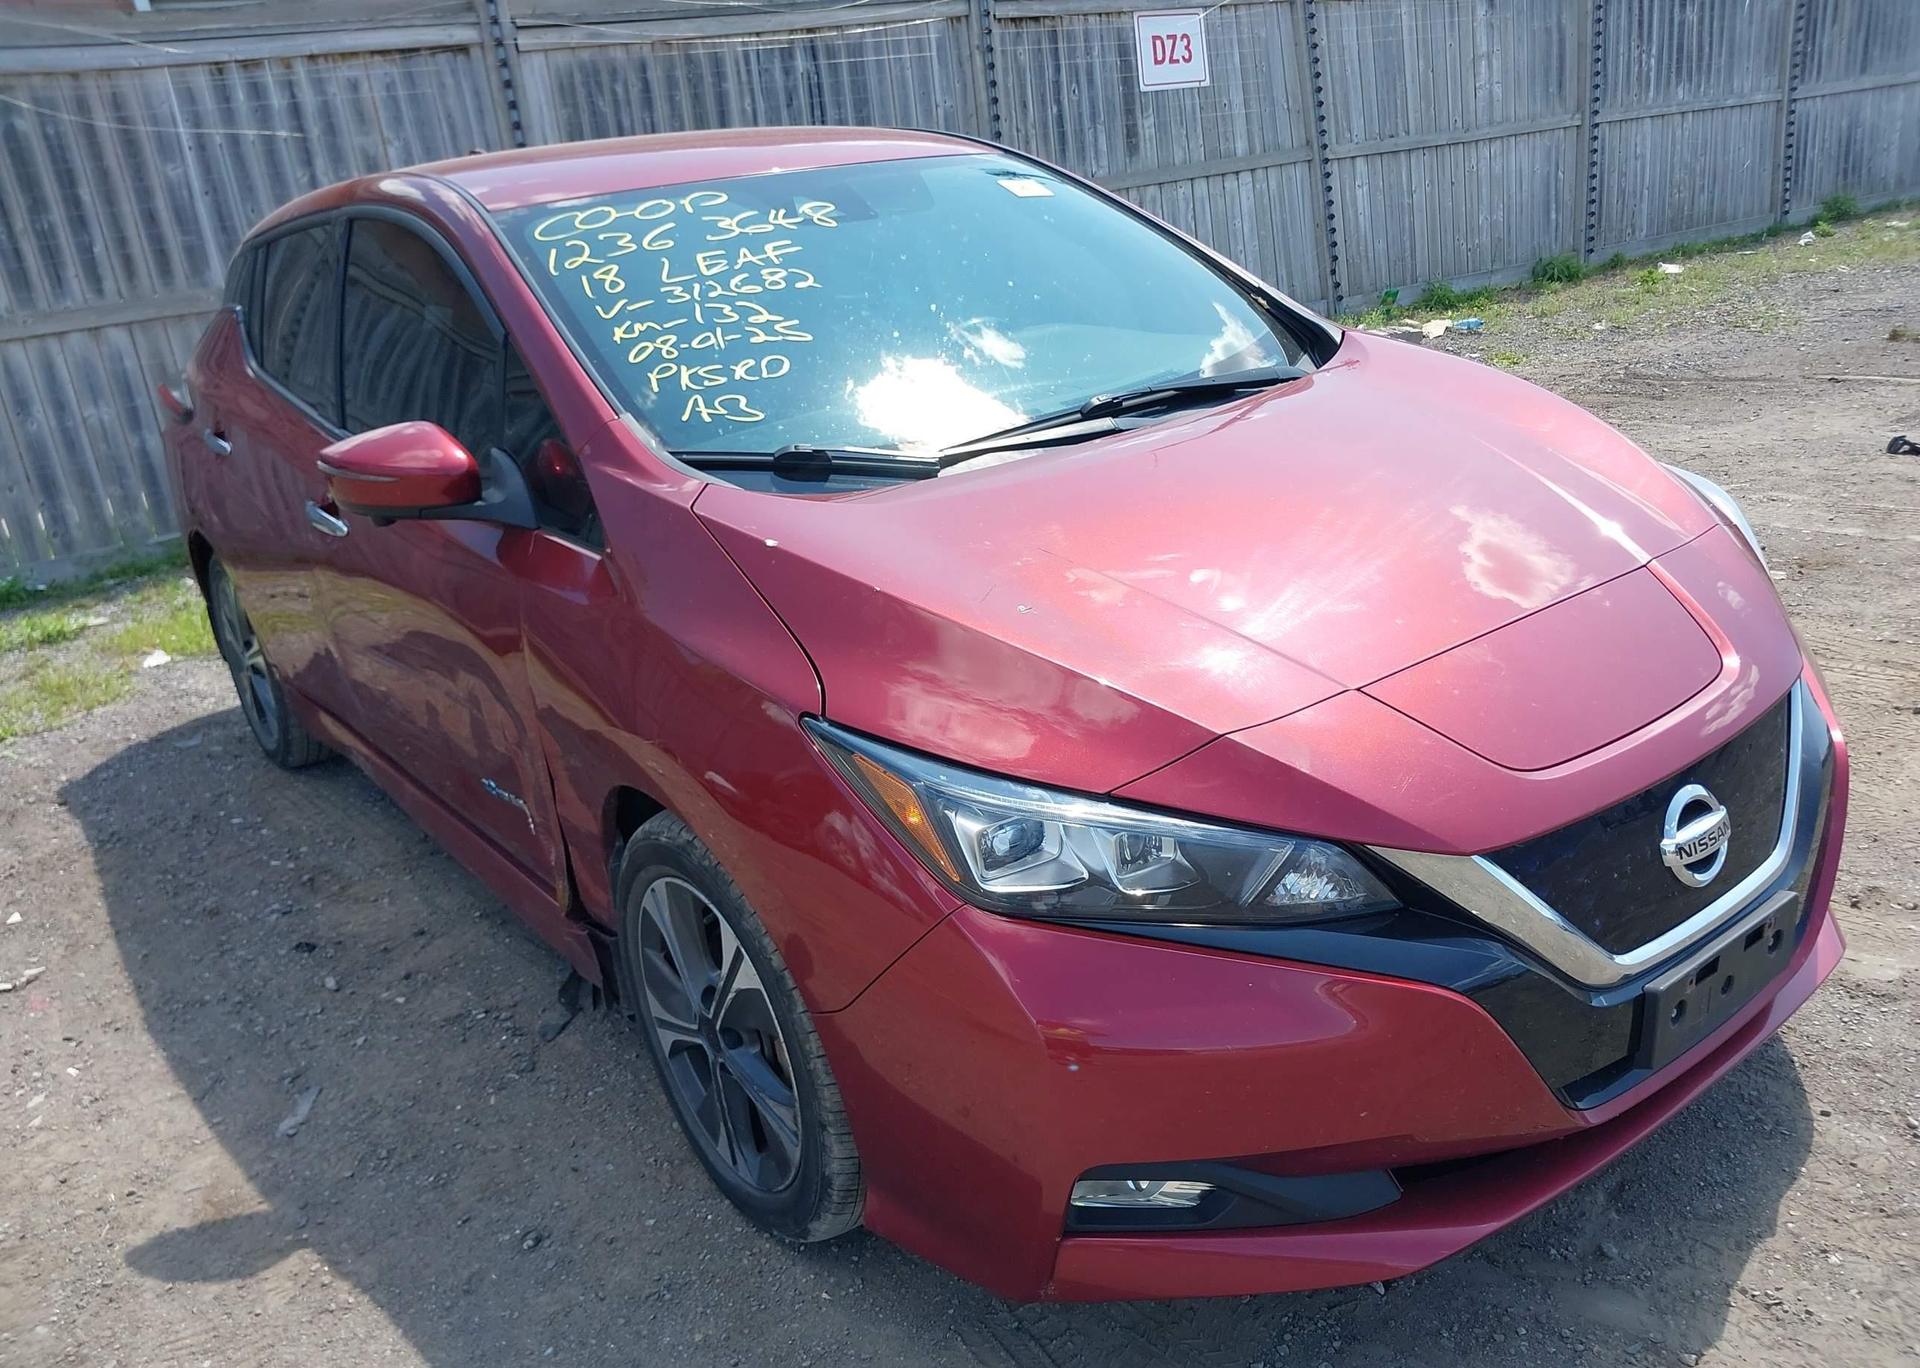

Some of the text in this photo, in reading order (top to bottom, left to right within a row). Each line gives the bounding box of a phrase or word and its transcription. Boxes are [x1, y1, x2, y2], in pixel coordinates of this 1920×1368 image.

[1151, 33, 1193, 65] DZ3
[550, 222, 677, 275] 1236
[581, 240, 803, 298] 18 LEAF
[1677, 821, 1730, 860] NISSAN
